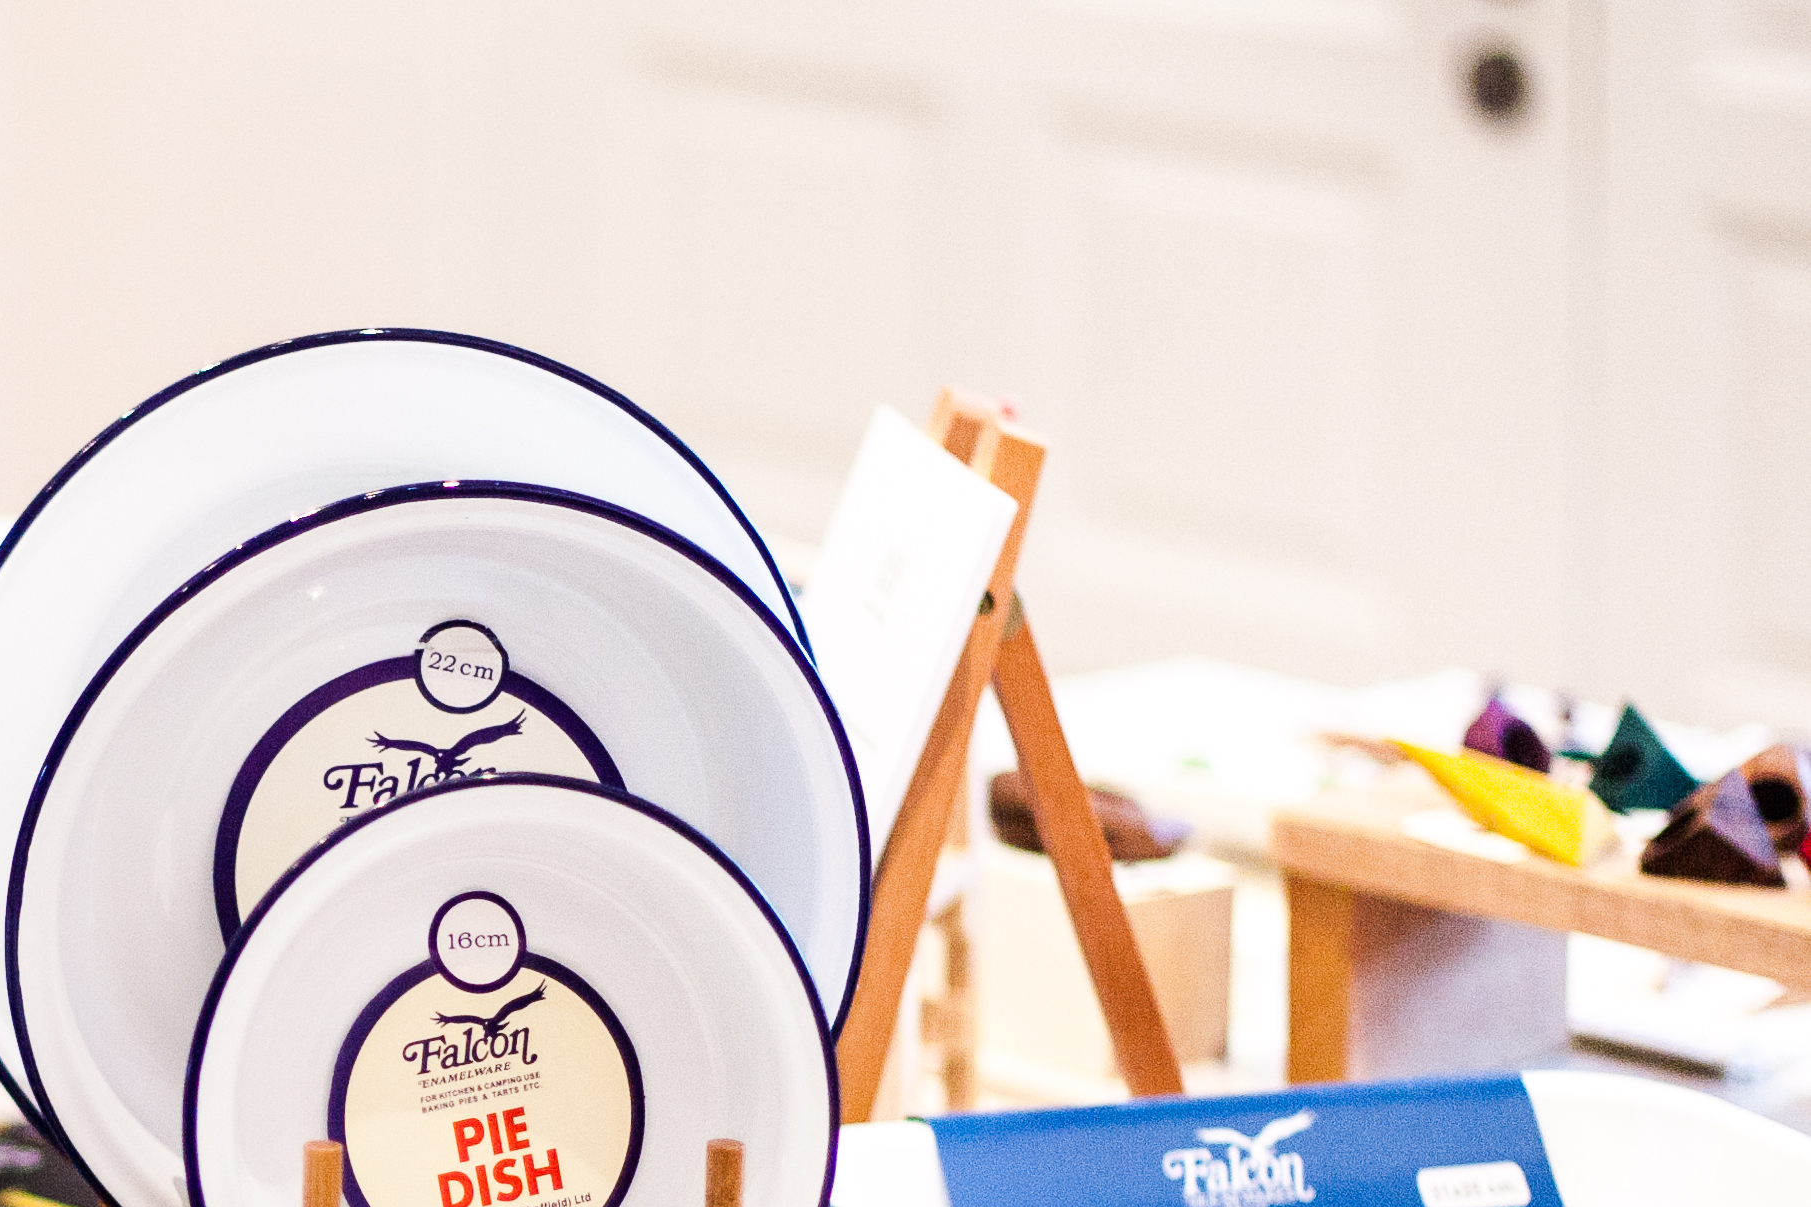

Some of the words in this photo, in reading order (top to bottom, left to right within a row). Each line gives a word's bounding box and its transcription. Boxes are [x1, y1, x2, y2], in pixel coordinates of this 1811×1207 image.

[427, 652, 495, 681] 22cm
[323, 757, 497, 809] Falc
[448, 931, 510, 950] 16cm
[402, 1027, 538, 1076] Falcon
[417, 1061, 512, 1089] ENAMELWARE
[420, 1093, 441, 1104] FOR
[439, 1085, 475, 1101] KITCHEN
[476, 1083, 483, 1092] &
[484, 1074, 523, 1090] CAMPING
[524, 1070, 541, 1081] USE
[421, 1101, 456, 1114] BAKING
[458, 1095, 479, 1105] PIES
[482, 1093, 488, 1101] &
[492, 1086, 519, 1098] TARTS
[452, 1106, 531, 1163] PIE
[1161, 1145, 1317, 1203] Falcon
[575, 1192, 592, 1205] Ltd
